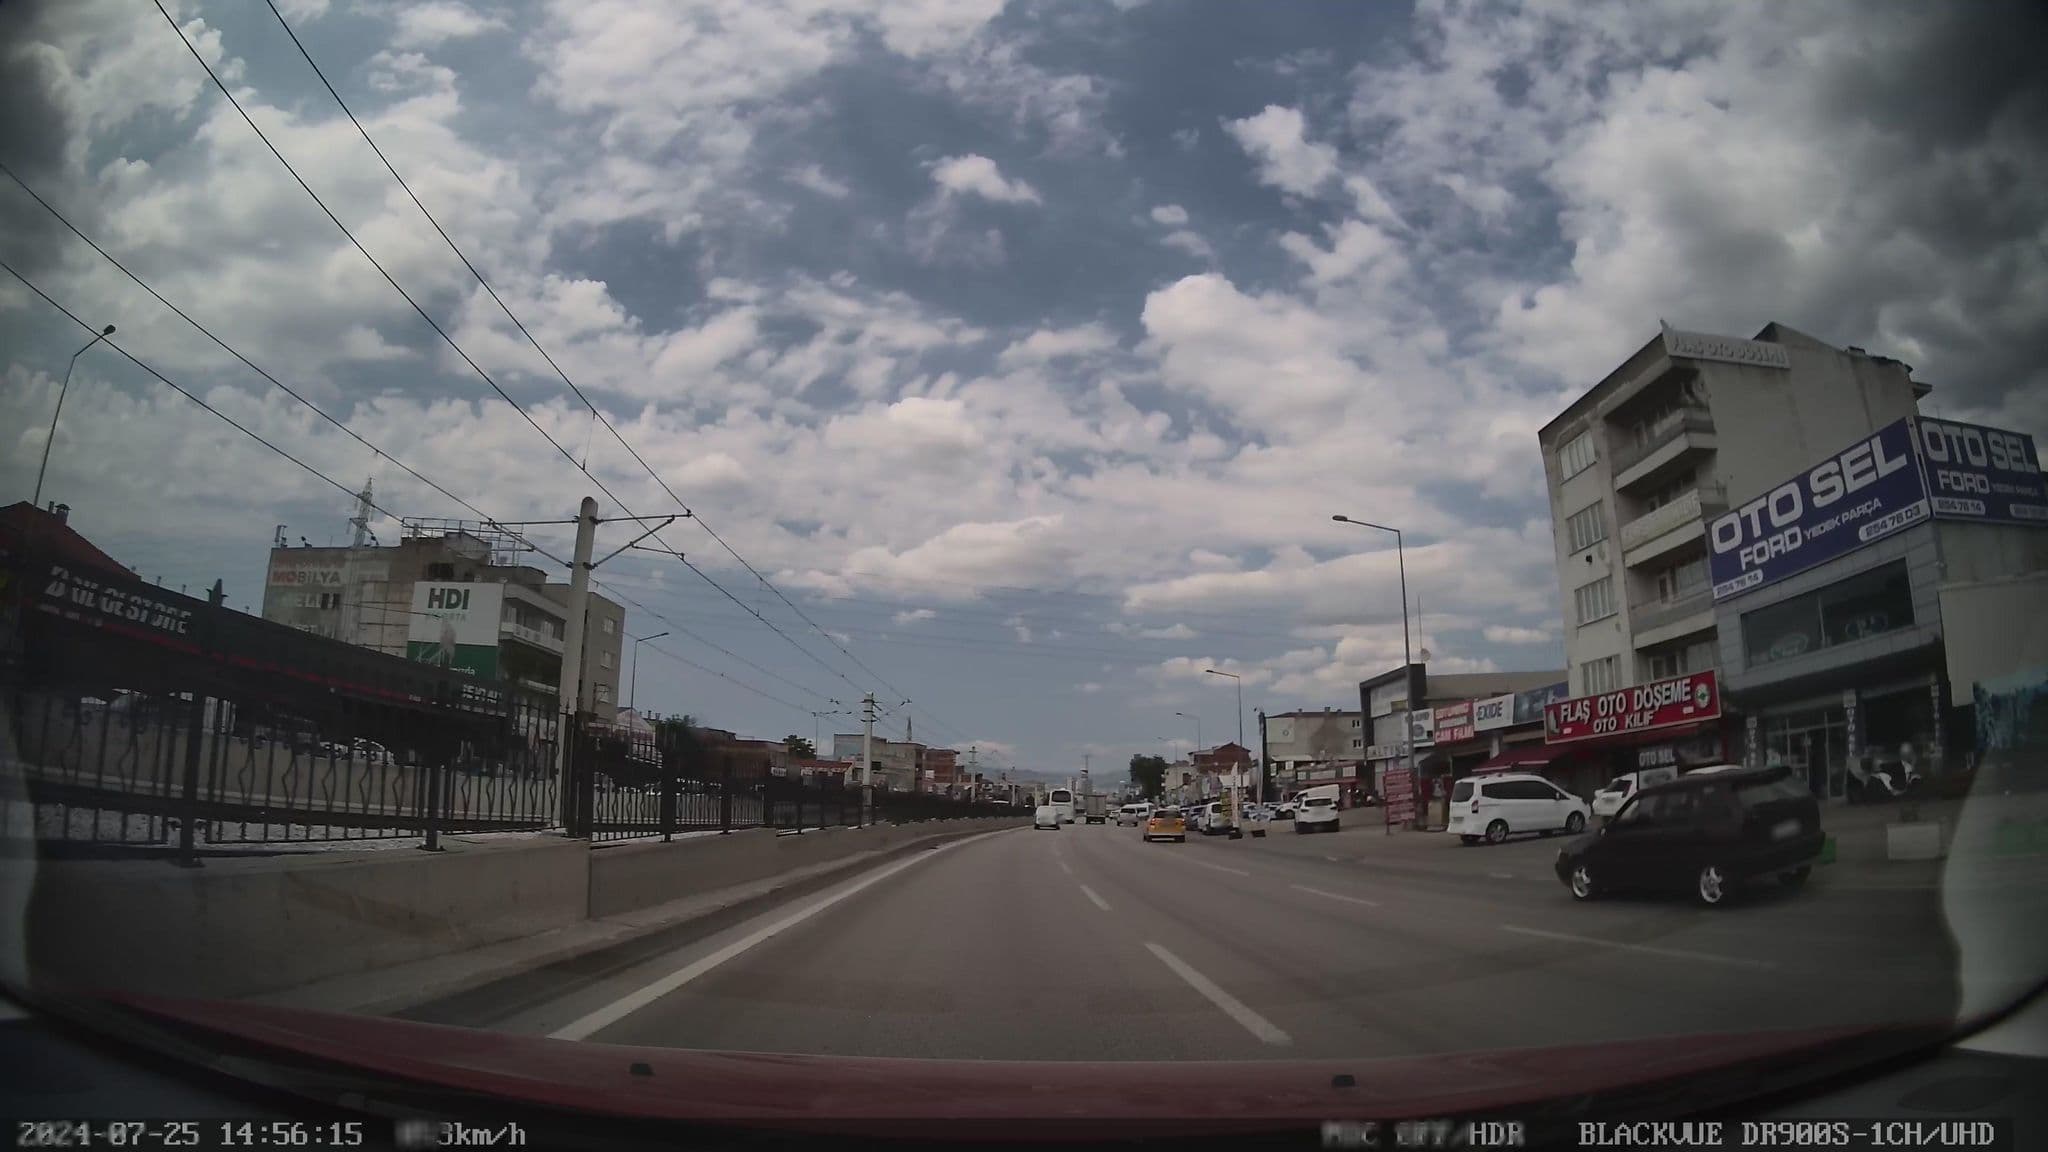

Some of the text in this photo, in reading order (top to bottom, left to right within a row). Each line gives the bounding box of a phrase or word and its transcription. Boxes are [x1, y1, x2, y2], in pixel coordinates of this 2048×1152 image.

[1920, 420, 2039, 475] OTO SEL
[1711, 481, 1804, 555] OTO
[1809, 434, 1909, 509] SEL
[1937, 469, 1990, 495] FORD
[1739, 525, 1802, 572] FORD
[1841, 497, 1883, 526] PARÇA
[427, 588, 471, 610] HDI
[1477, 701, 1503, 721] EXIDE
[1560, 699, 1591, 725] FLAŞ
[1597, 692, 1627, 717] OTO
[1633, 677, 1692, 712] DÖŞEME
[1593, 711, 1655, 733] OTO KILIF
[1638, 751, 1657, 767] OTO
